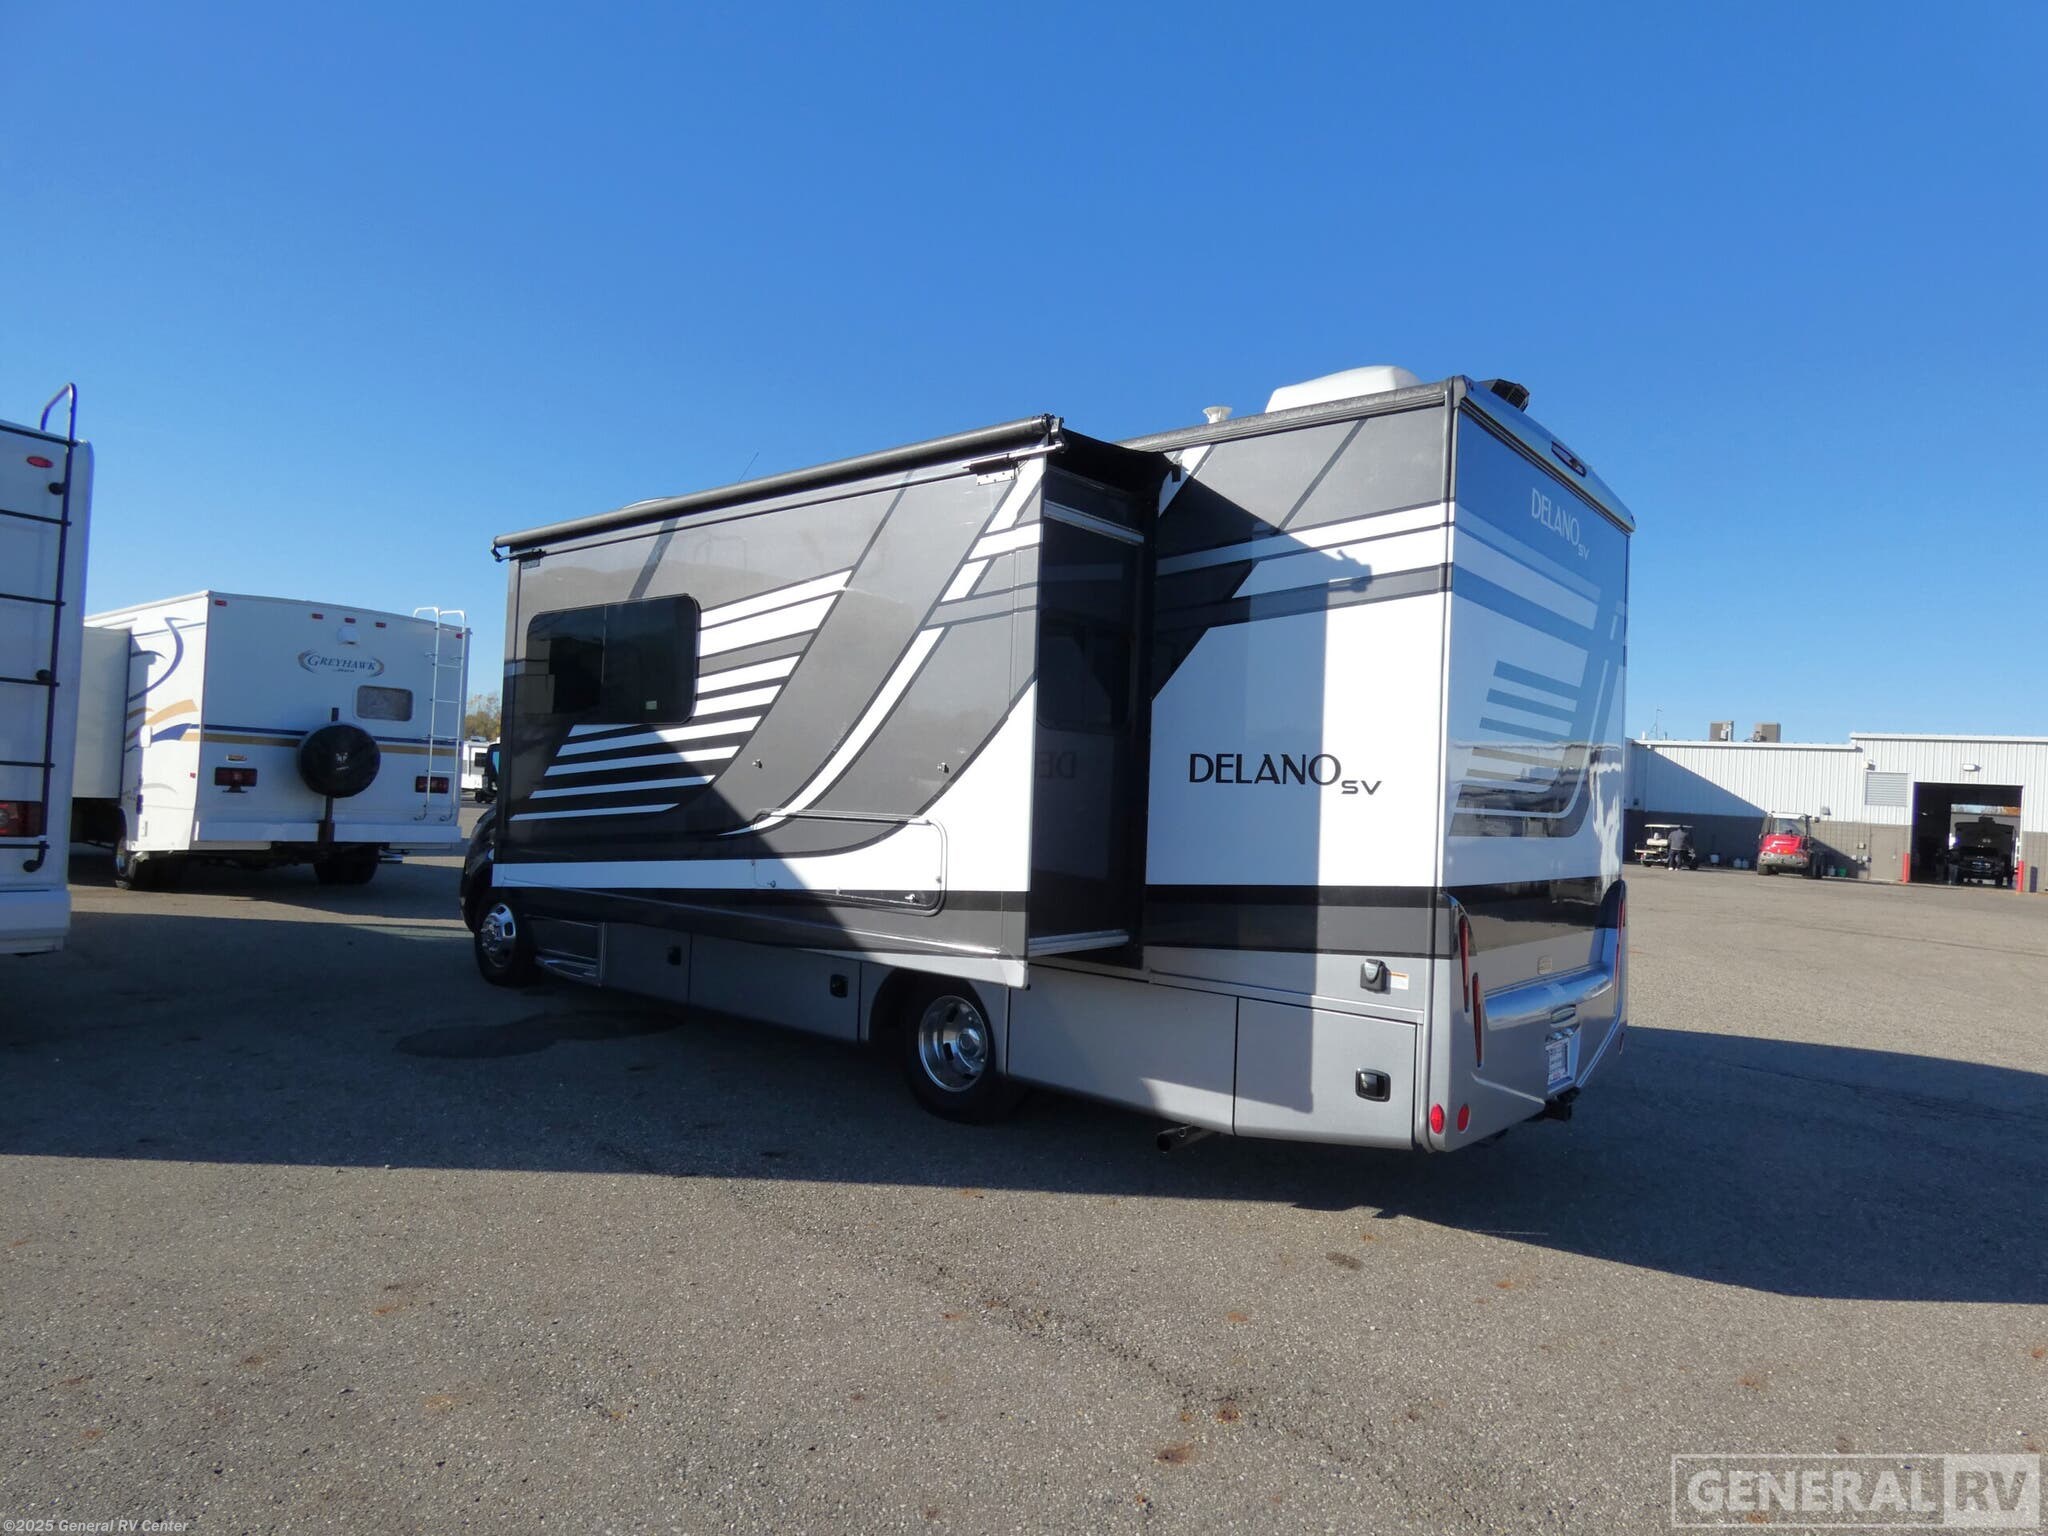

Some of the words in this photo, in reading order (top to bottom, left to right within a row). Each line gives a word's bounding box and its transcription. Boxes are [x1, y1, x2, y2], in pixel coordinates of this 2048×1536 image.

[1531, 487, 1580, 546] DELANO
[1577, 543, 1590, 560] SV
[307, 654, 376, 671] GREYHAWK
[1189, 753, 1342, 786] DELANO
[1341, 780, 1382, 796] SV
